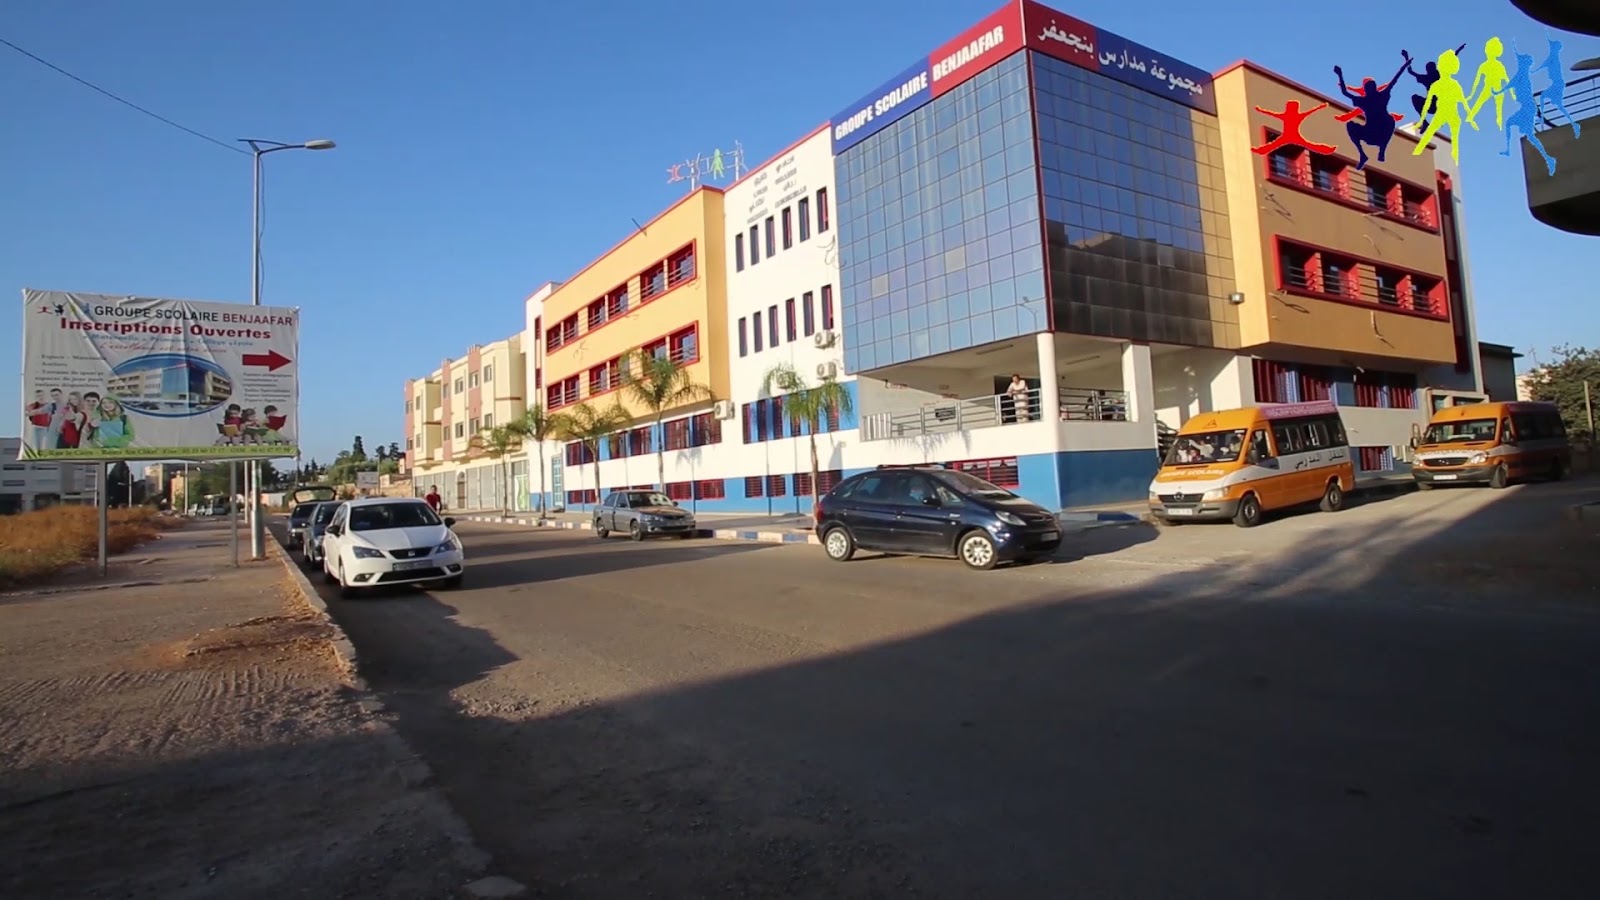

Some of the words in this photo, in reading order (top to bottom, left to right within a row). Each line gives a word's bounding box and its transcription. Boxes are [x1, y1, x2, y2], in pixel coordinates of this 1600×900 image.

[1037, 19, 1095, 60] بنجعفر
[1098, 49, 1147, 74] مدارس
[1150, 58, 1203, 96] مجموعة
[835, 104, 874, 141] GROUPE
[874, 71, 928, 117] SCOLAIRE
[932, 25, 1005, 82] BENJAAFAR
[60, 317, 183, 336] Inscriptions
[190, 324, 272, 340] Ouvertes
[94, 305, 151, 318] GROUPE
[155, 309, 219, 322] SCOLAIRE
[222, 314, 293, 327] BENJAAFAR
